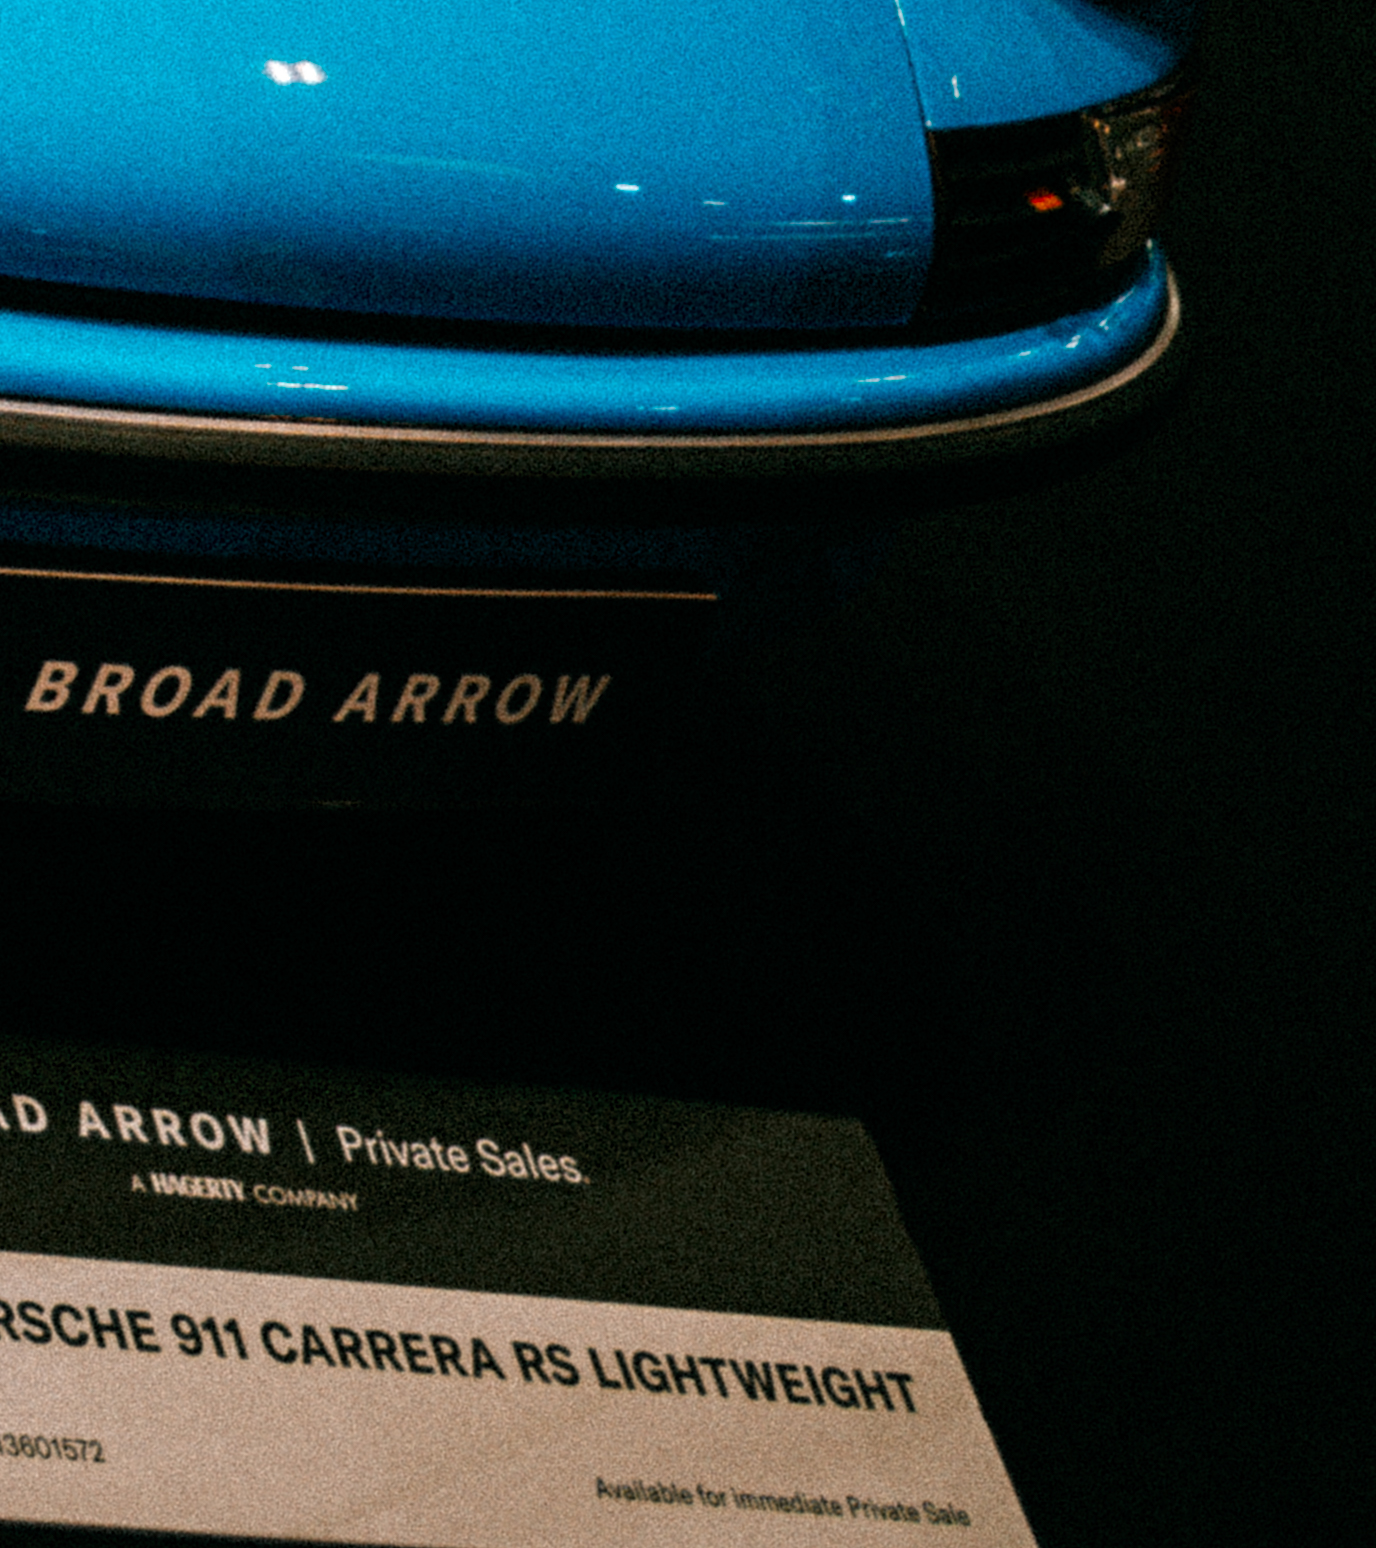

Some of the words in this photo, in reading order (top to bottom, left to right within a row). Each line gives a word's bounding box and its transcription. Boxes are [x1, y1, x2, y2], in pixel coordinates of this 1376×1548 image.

[24, 659, 307, 722] BROAD
[332, 672, 611, 725] ARROW
[77, 1100, 272, 1156] ARROW
[335, 1124, 471, 1174] Private
[131, 1174, 147, 1192] A
[150, 1172, 246, 1202] HAGERTY
[252, 1183, 359, 1211] COMPANY
[171, 1313, 249, 1360] 911
[260, 1320, 507, 1380] CARRERA
[512, 1340, 580, 1386] RS
[587, 1348, 917, 1414] LIGHTWEIGHT
[595, 1476, 694, 1506] Available
[696, 1484, 728, 1509] for
[846, 1496, 920, 1525] Private
[924, 1502, 972, 1528] Sale
